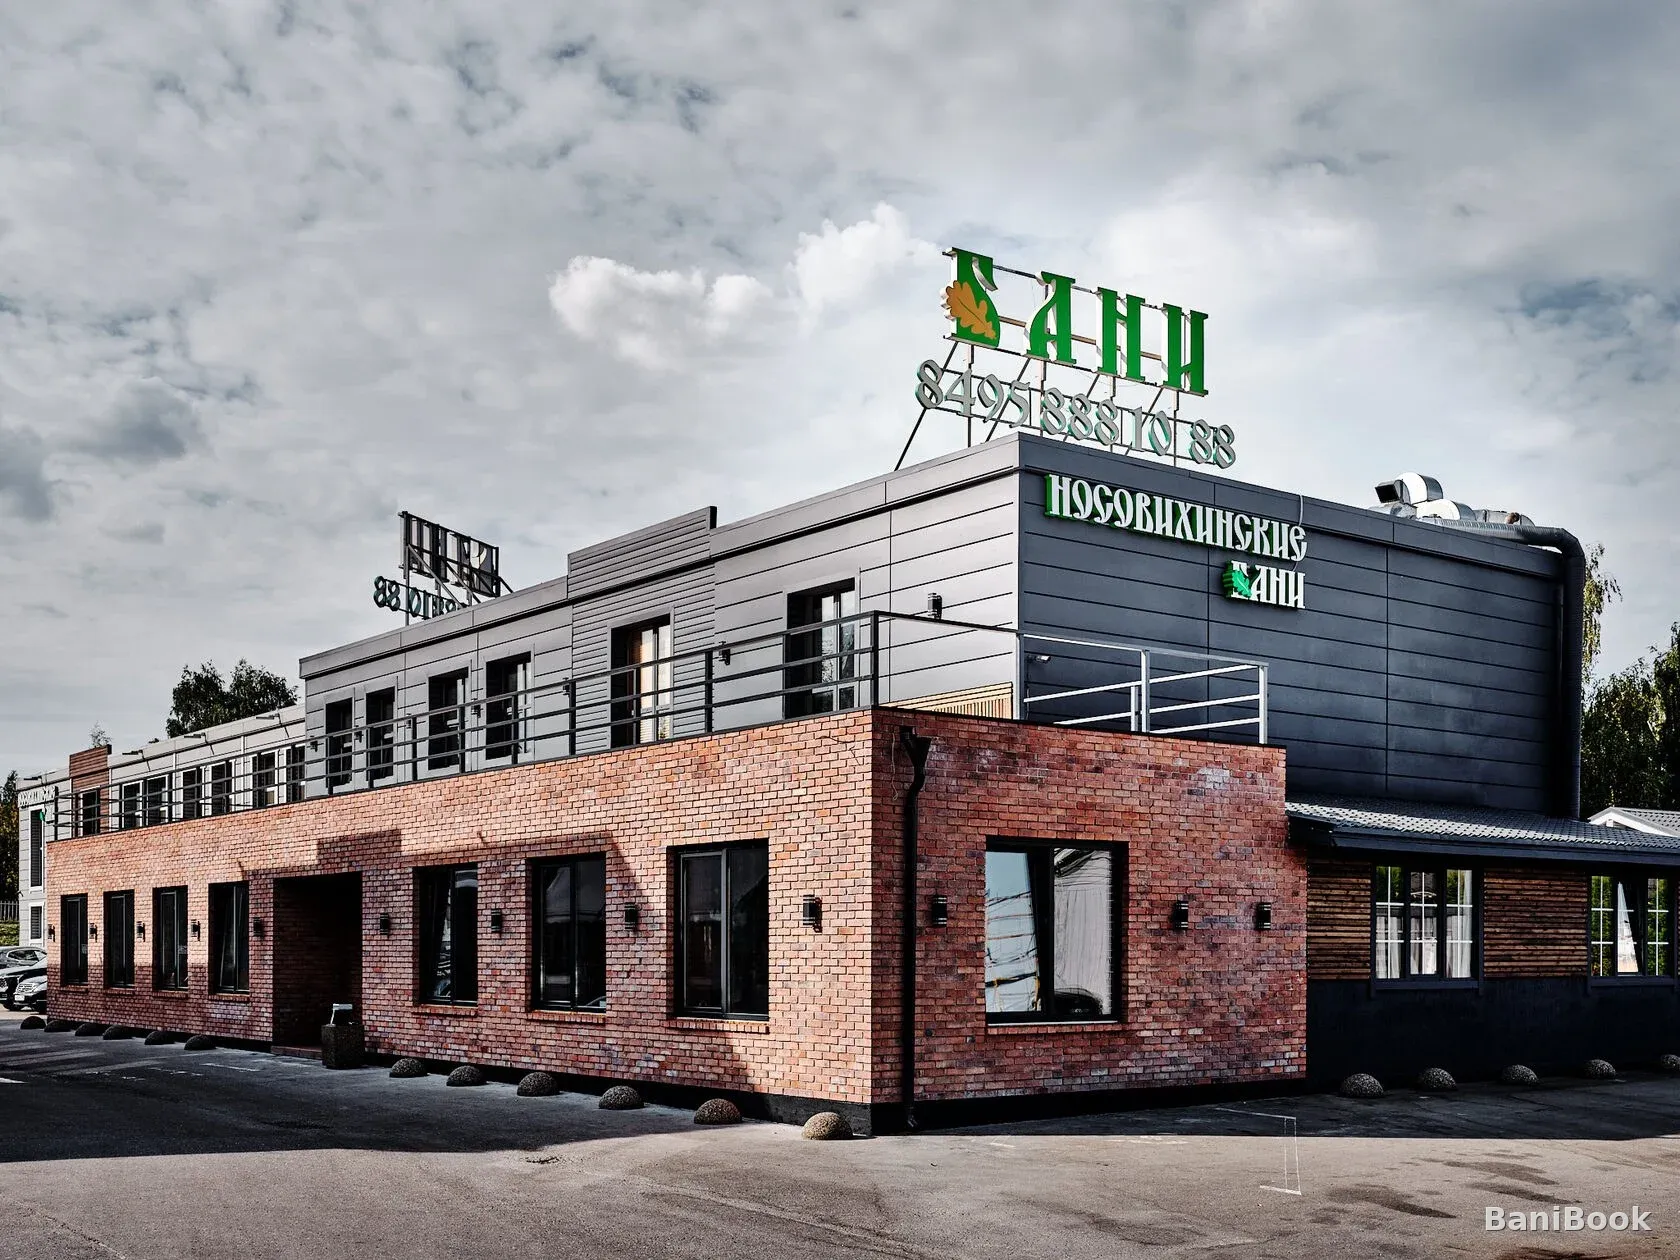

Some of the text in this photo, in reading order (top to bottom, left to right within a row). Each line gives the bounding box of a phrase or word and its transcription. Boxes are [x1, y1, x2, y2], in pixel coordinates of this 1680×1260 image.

[943, 247, 1208, 397] БАНИ
[915, 359, 1236, 469] 8495 888 10 88
